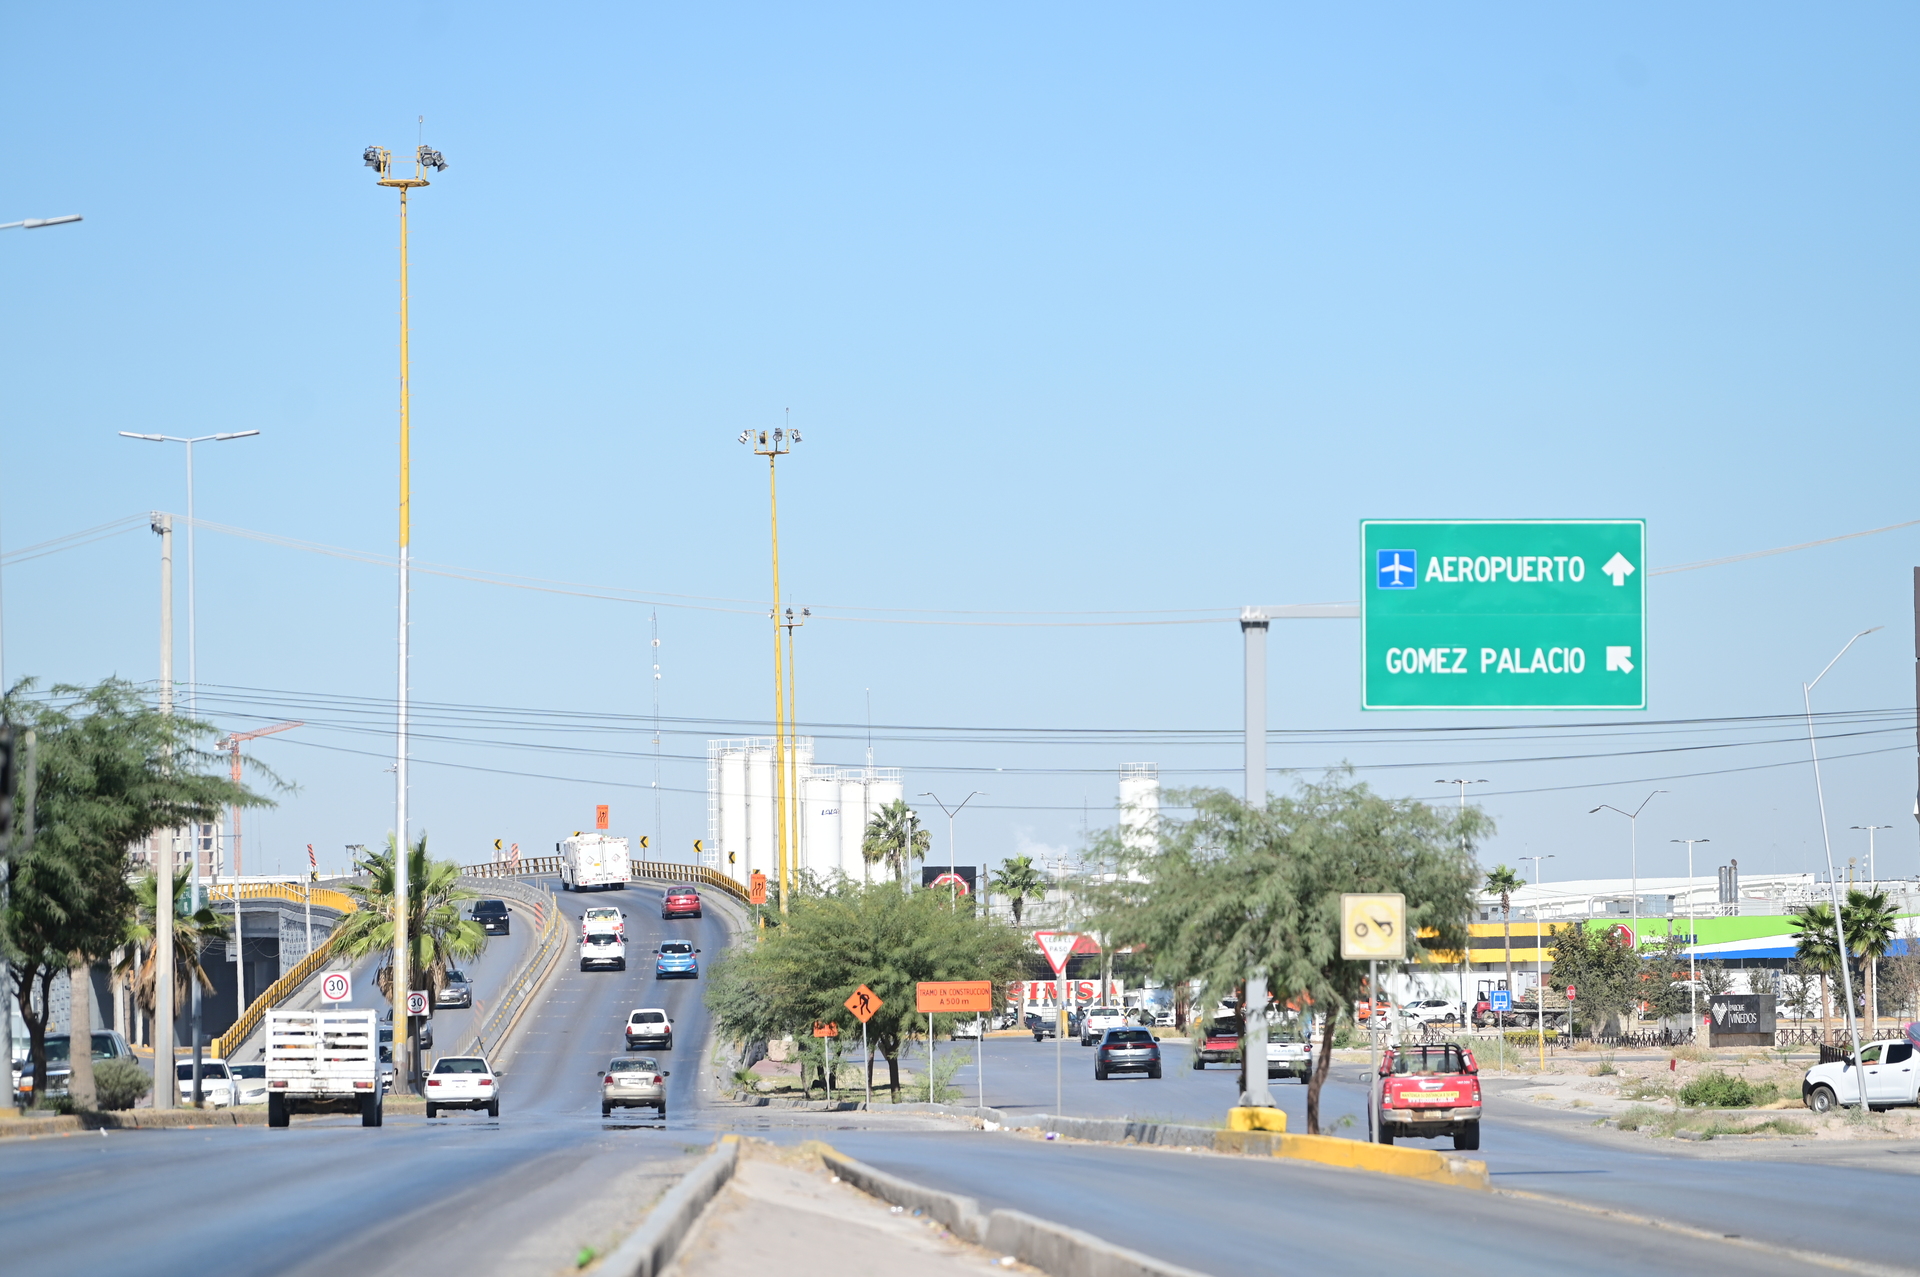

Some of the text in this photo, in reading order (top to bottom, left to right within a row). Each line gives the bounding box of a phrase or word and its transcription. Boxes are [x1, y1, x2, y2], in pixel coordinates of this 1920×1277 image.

[1424, 556, 1585, 582] AEROPUERTO
[1386, 647, 1585, 674] GOMEZ PALACIO
[329, 979, 344, 992] 30
[1006, 981, 1119, 1001] SIMSA
[940, 988, 947, 996] EN
[949, 988, 989, 996] CONSTRUCCION
[410, 997, 423, 1007] 30
[1729, 1004, 1745, 1012] PARQUE
[1730, 1012, 1757, 1024] VIÑEDOS
